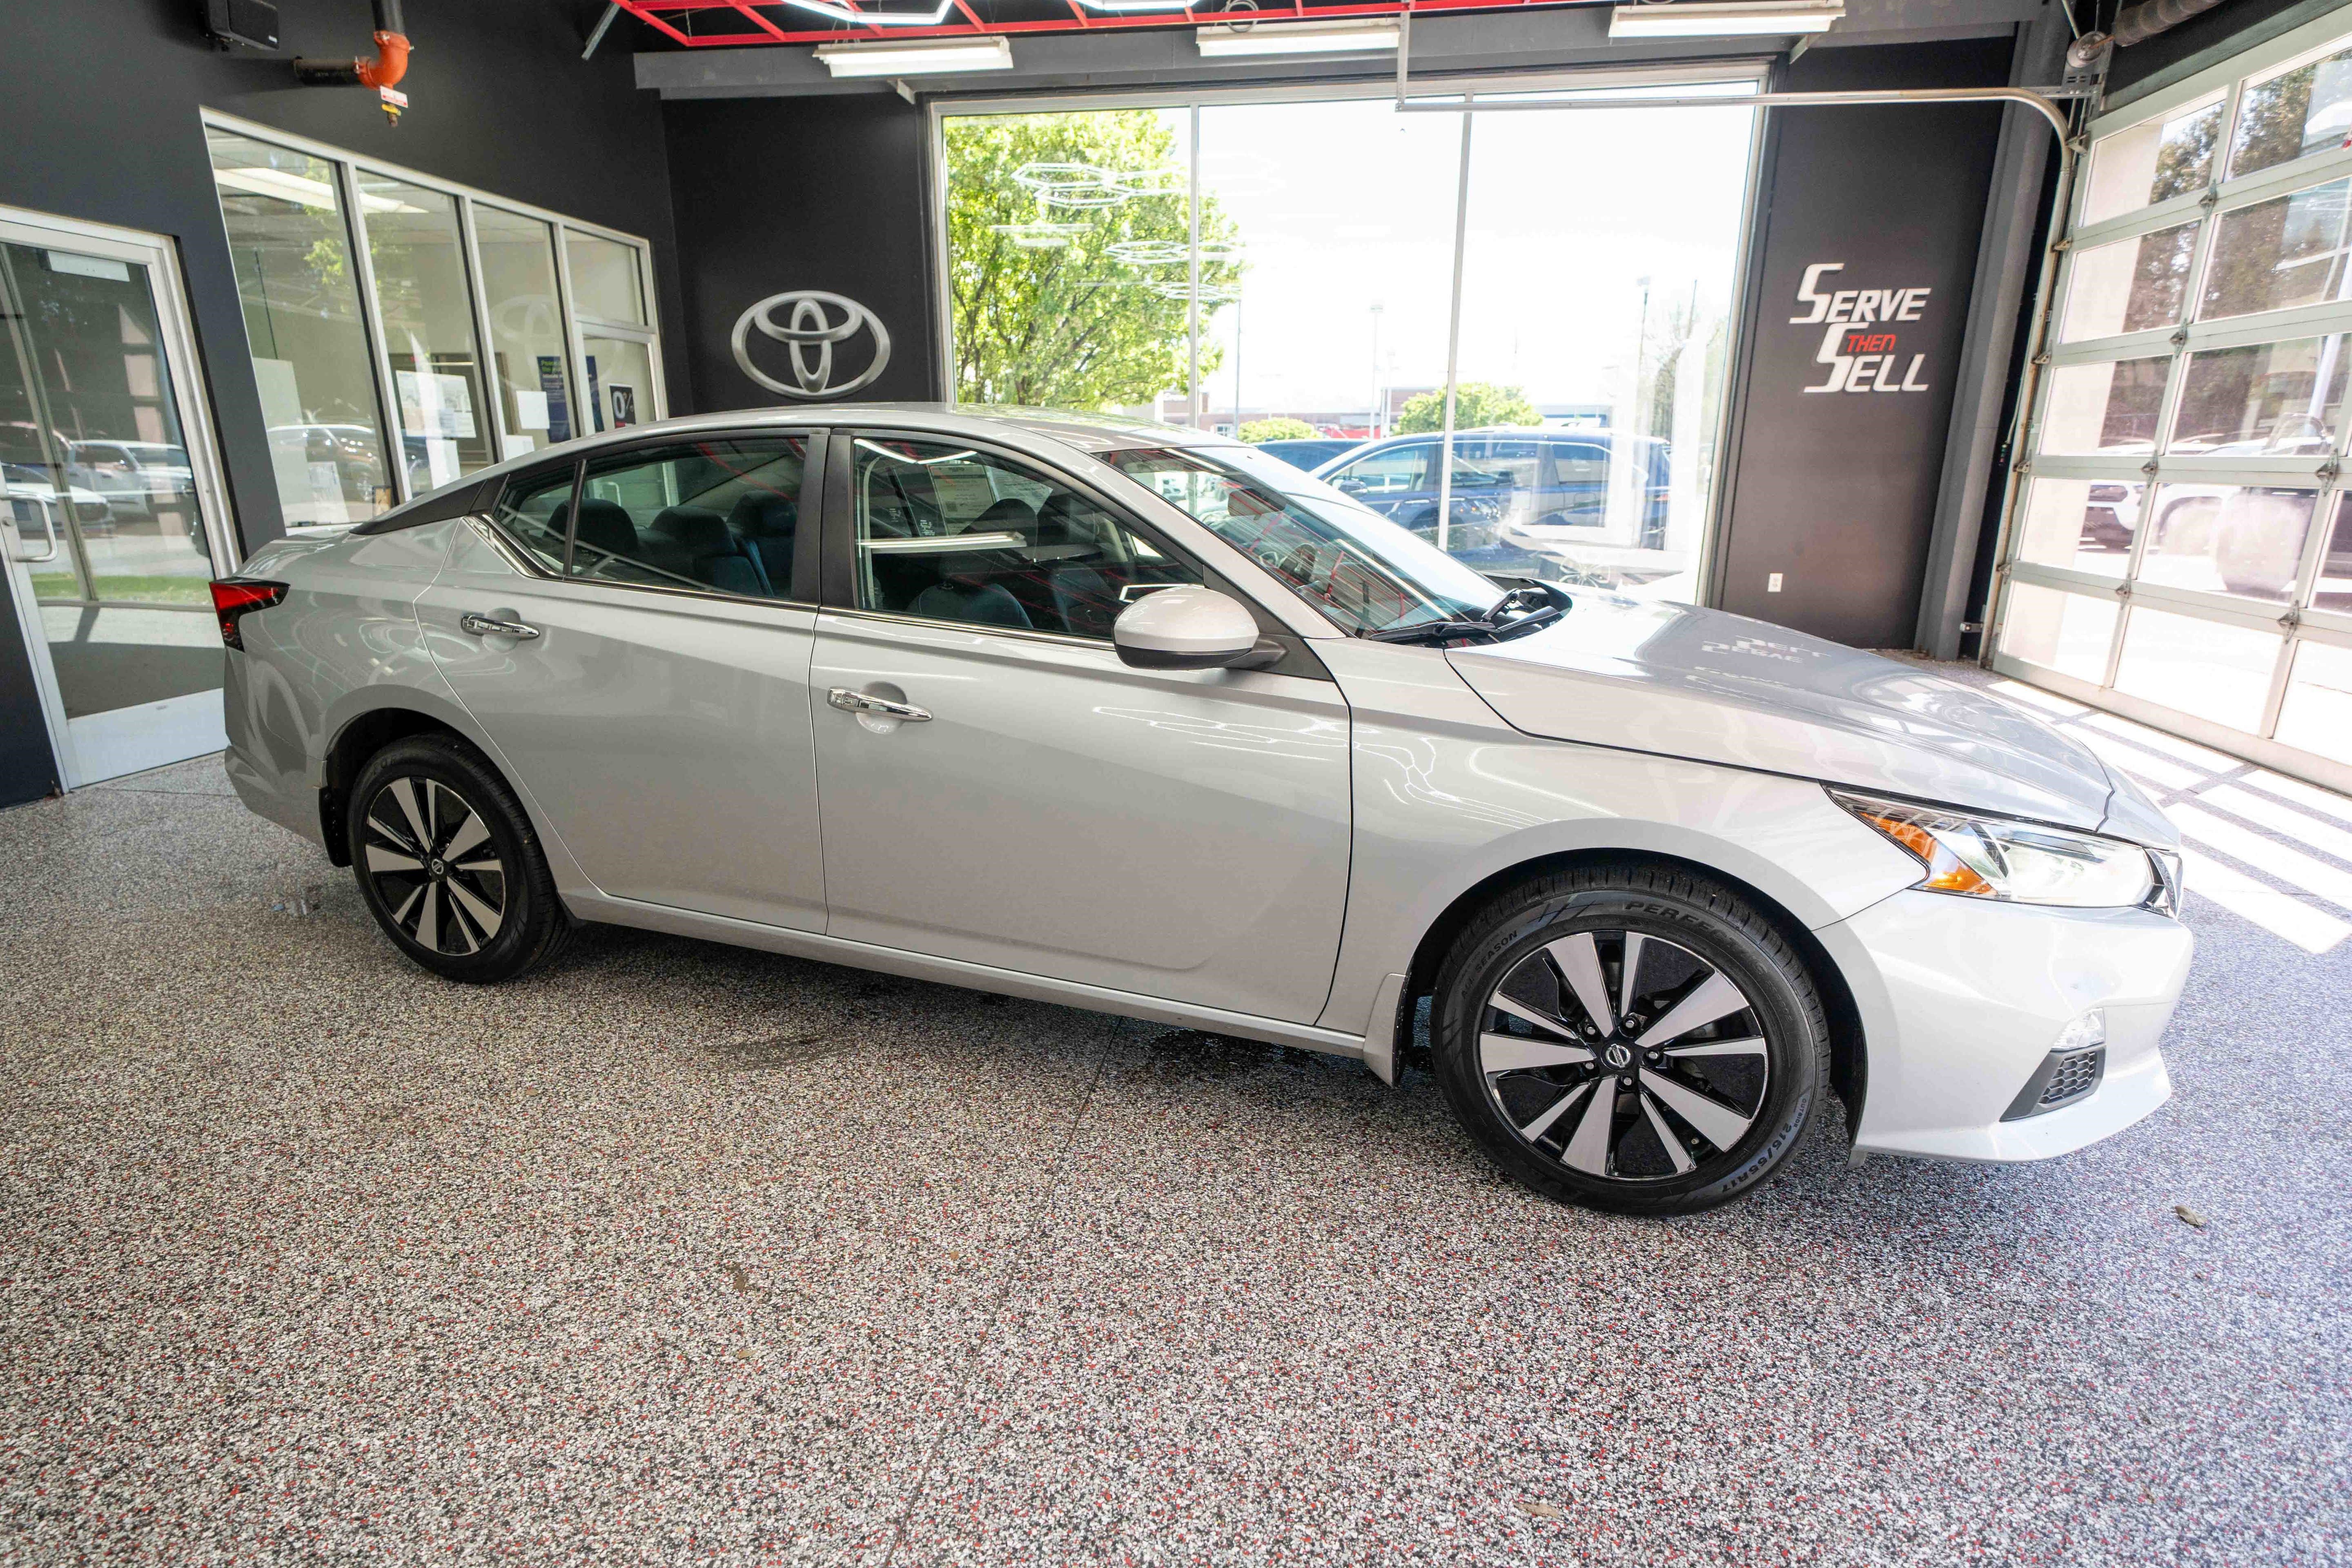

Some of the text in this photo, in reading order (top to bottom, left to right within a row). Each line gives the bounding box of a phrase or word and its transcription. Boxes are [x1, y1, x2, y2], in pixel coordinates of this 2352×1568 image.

[1789, 263, 1932, 324] SERVE
[1804, 322, 1929, 393] SELL
[1847, 334, 1896, 352] THEN
[612, 390, 634, 419] 0%
[1475, 930, 1517, 972] SEASON
[1611, 1045, 1624, 1066] NISSAN
[1722, 1123, 1792, 1192] 215/55R17
